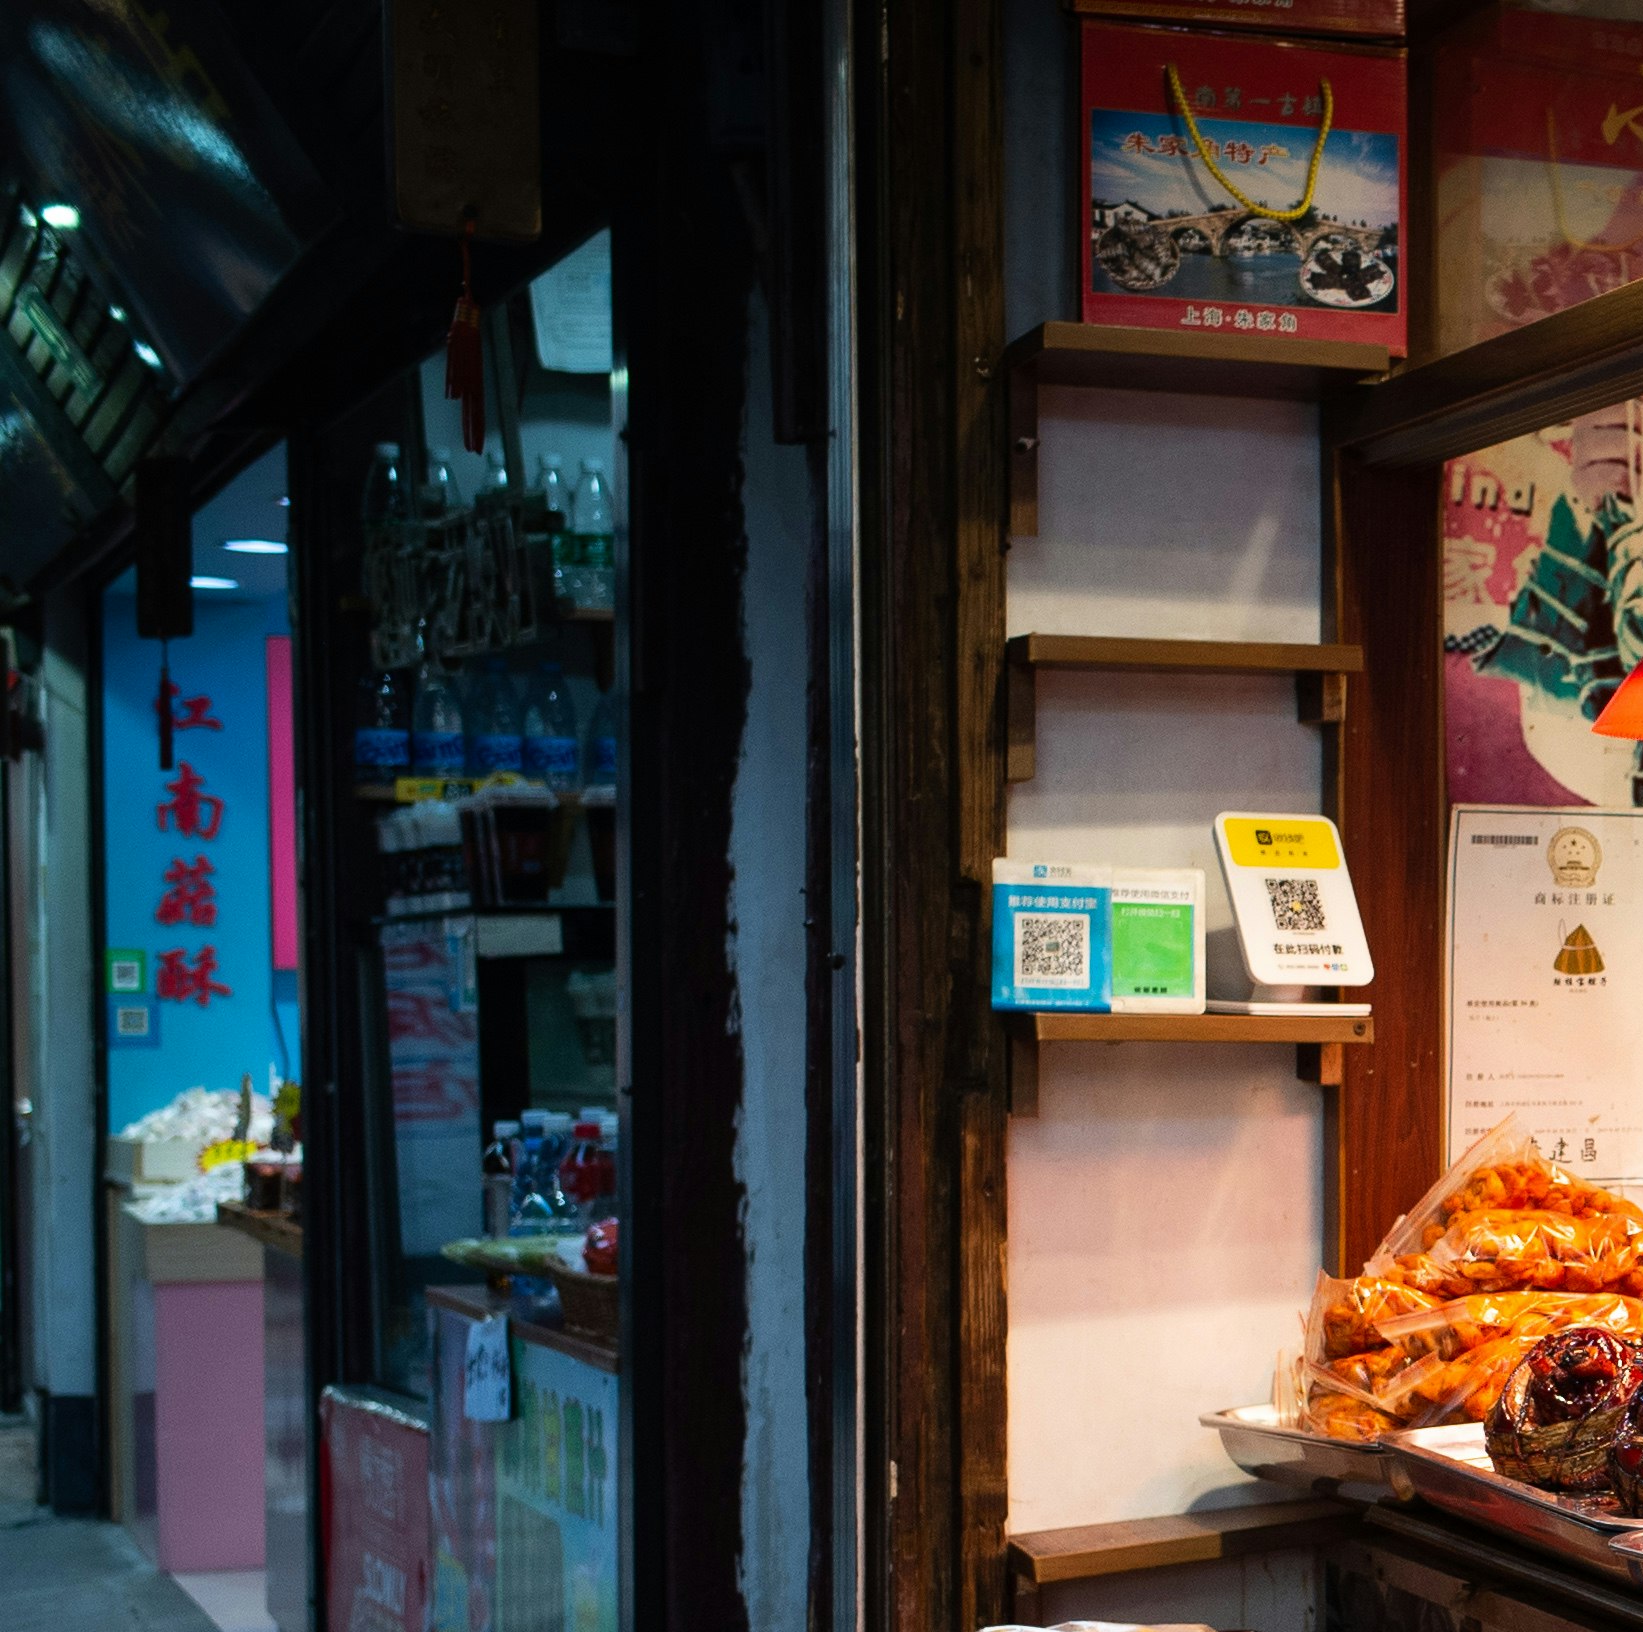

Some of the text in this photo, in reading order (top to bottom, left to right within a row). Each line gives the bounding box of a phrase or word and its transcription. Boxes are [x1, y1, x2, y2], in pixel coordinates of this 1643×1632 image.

[1179, 85, 1323, 117] 南第一古镇
[1534, 891, 1616, 906] 商标注册证
